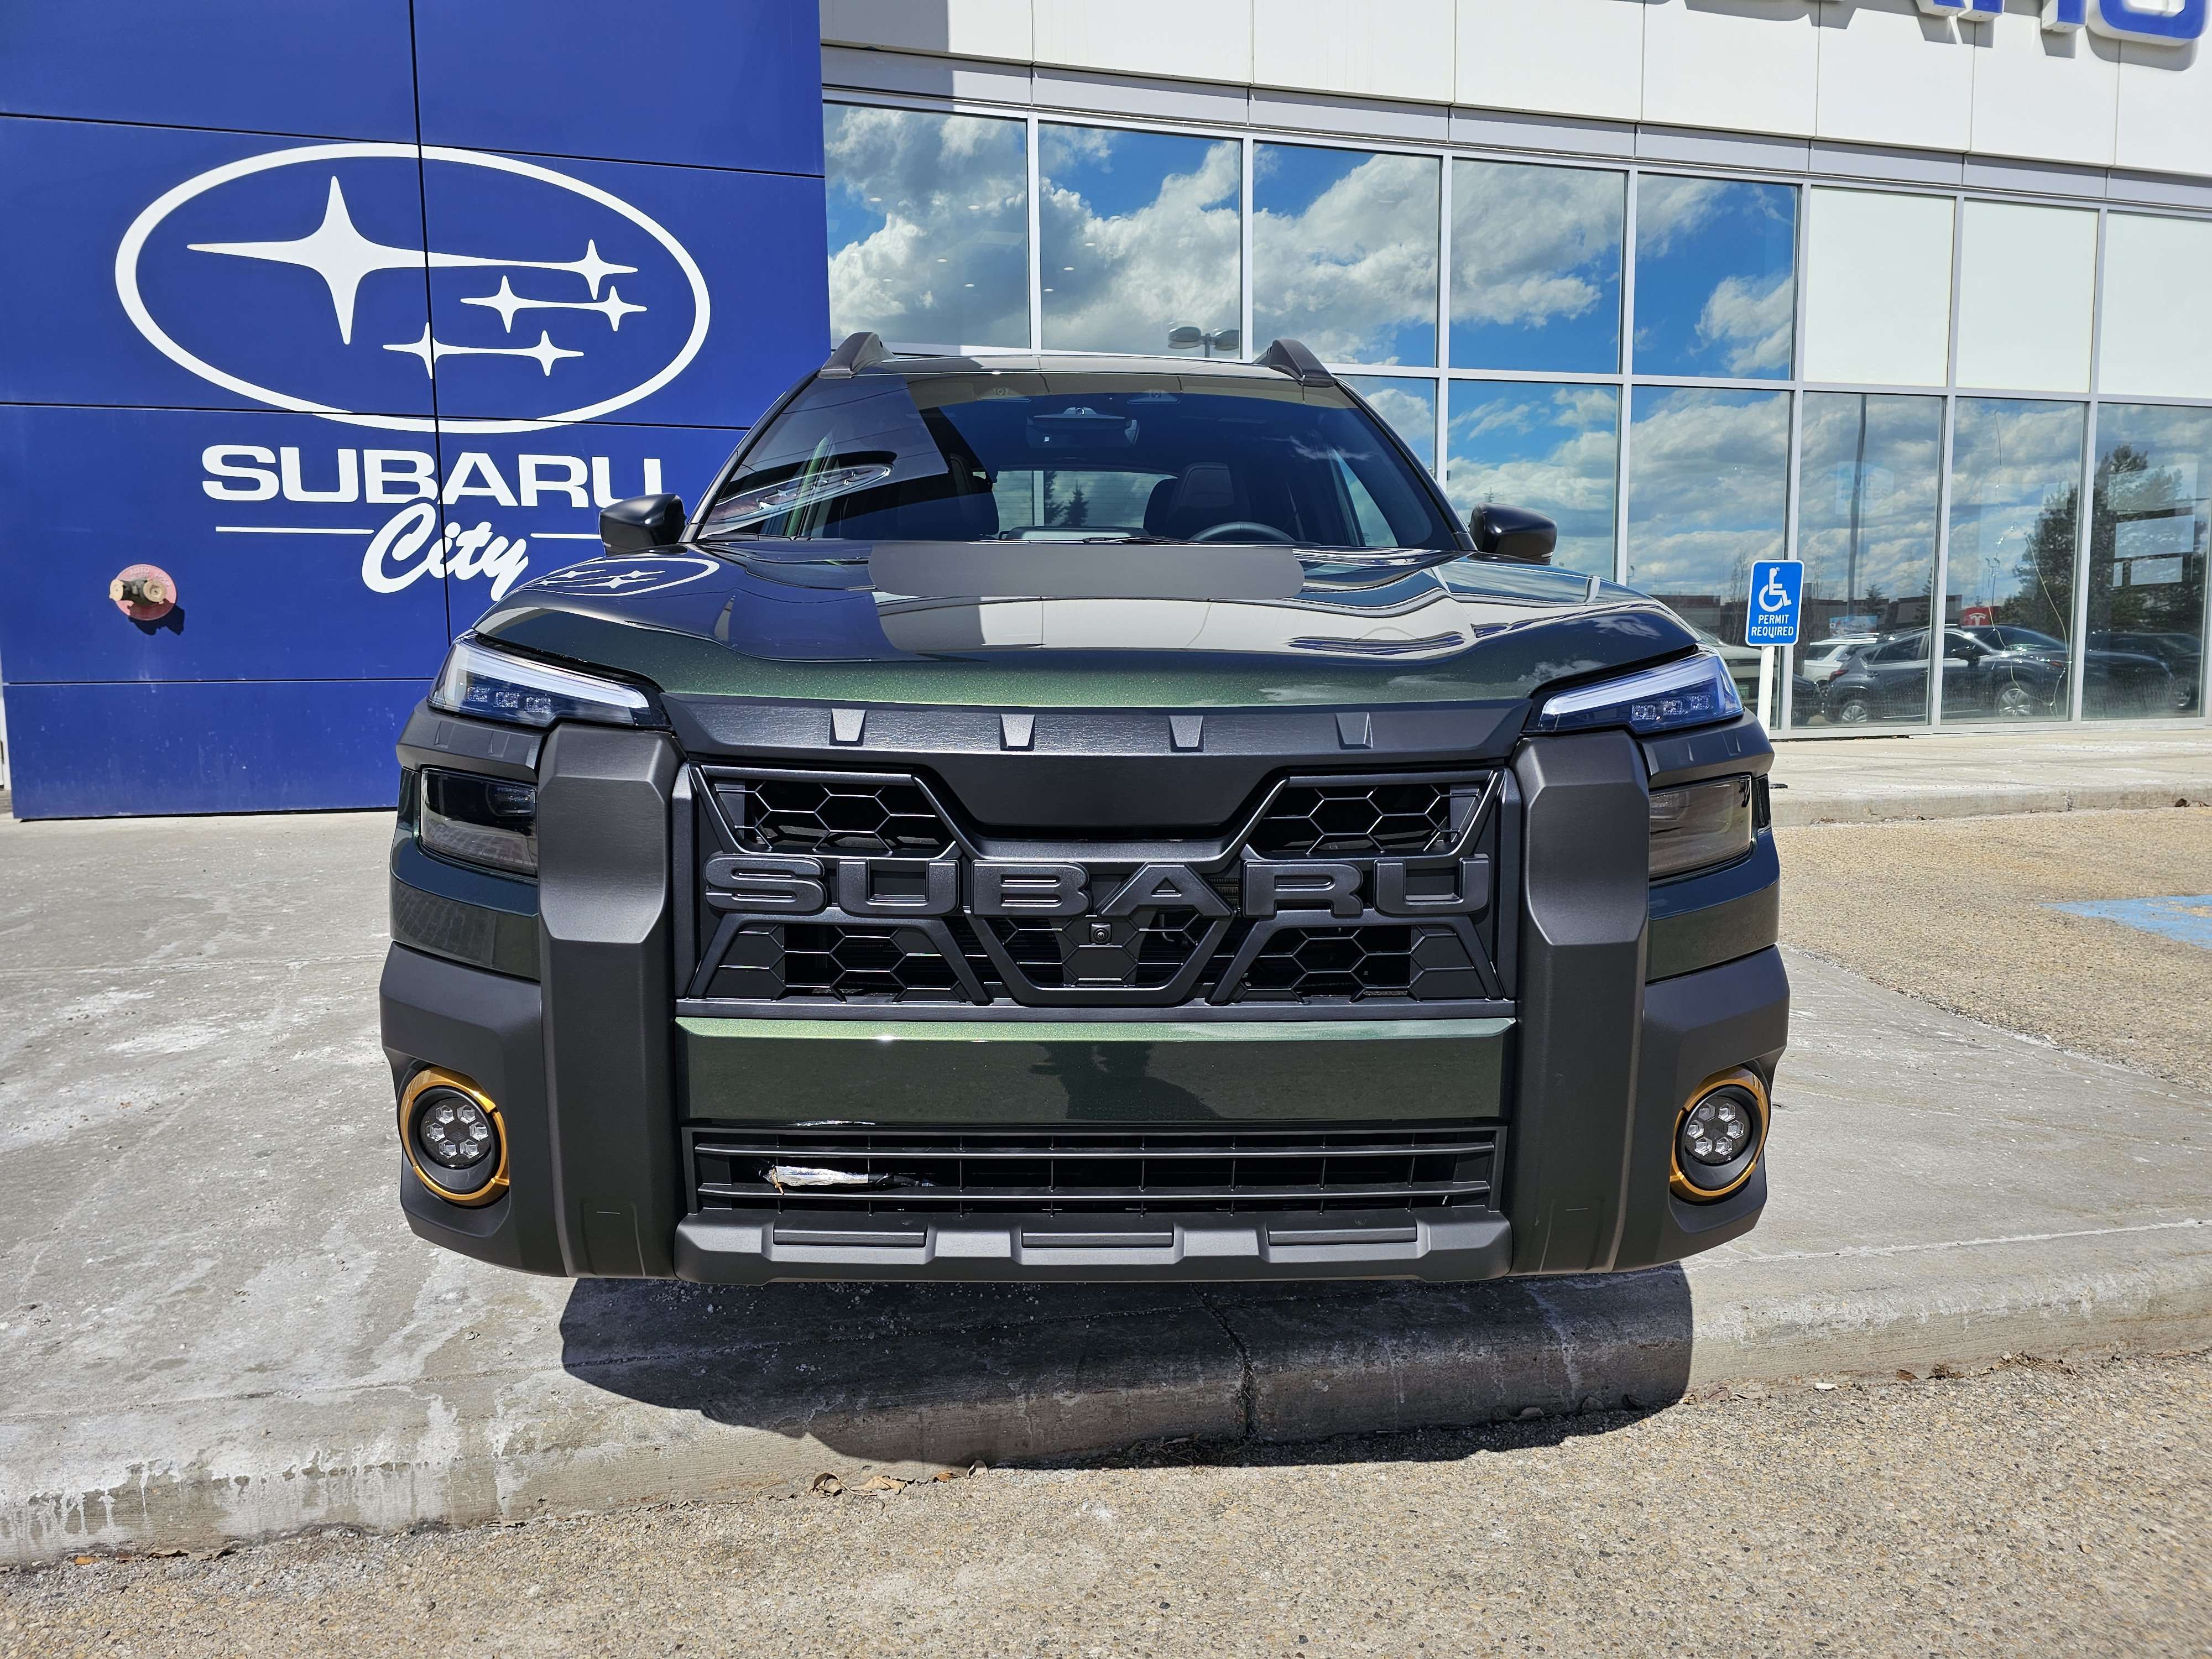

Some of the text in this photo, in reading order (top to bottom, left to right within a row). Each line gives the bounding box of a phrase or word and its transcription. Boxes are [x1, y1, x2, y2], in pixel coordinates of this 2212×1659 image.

[202, 445, 661, 509] SUBARU
[362, 502, 529, 602] City
[1751, 626, 1794, 636] REQUIRED
[1759, 614, 1789, 624] PERMIT
[703, 852, 1492, 919] SUBARU
